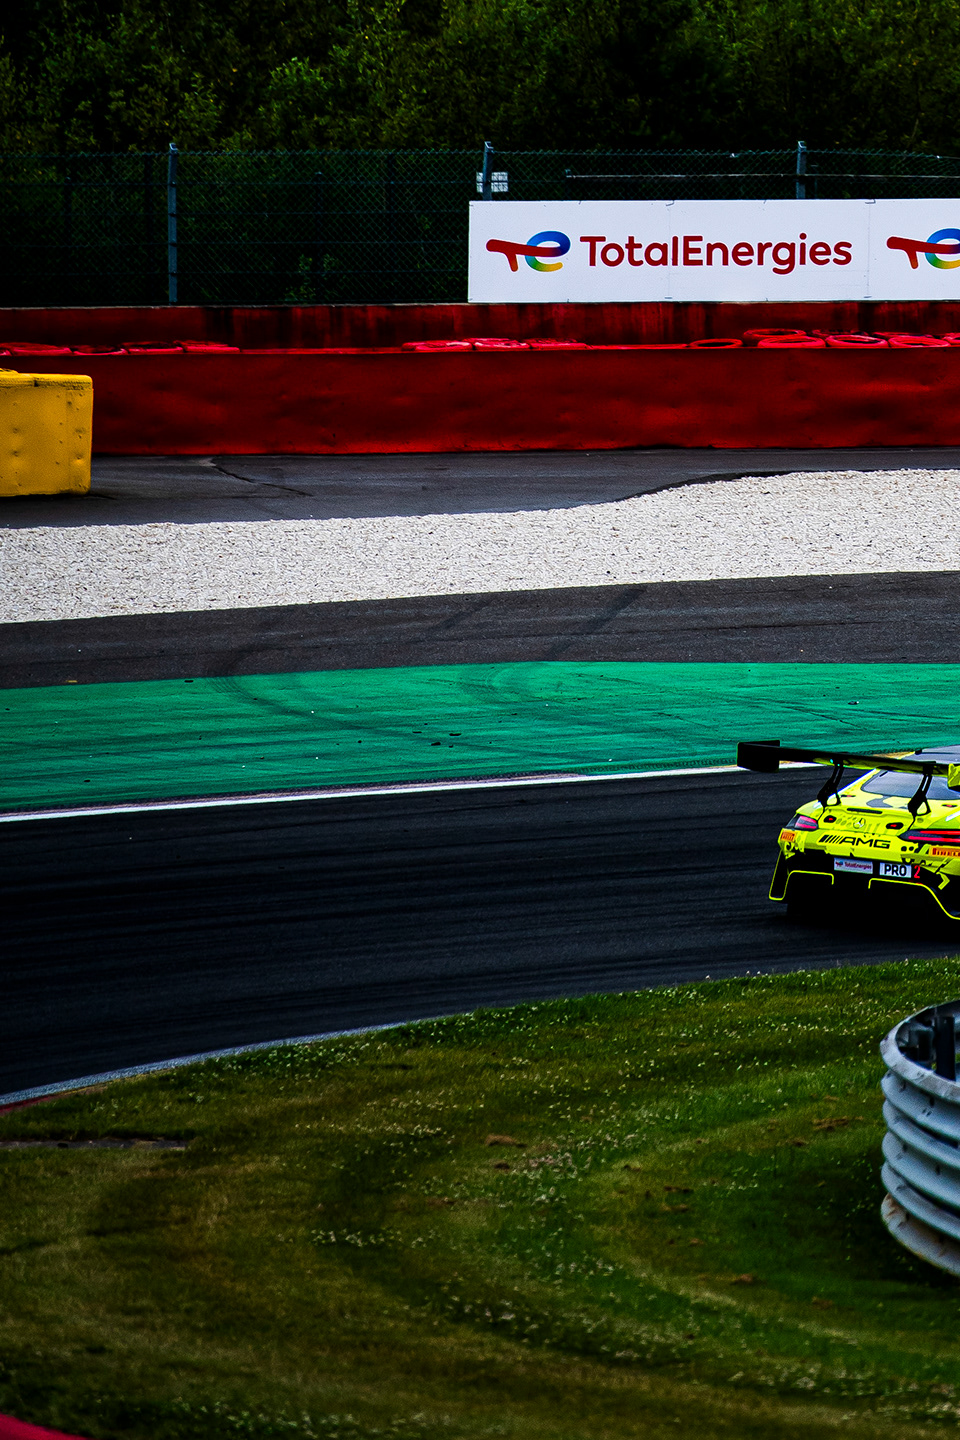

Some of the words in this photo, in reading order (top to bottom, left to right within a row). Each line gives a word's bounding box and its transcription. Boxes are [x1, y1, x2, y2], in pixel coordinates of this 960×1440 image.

[580, 233, 852, 275] TotalEnergies
[838, 836, 891, 849] AMG
[884, 863, 907, 876] PRO
[913, 865, 920, 878] 2
